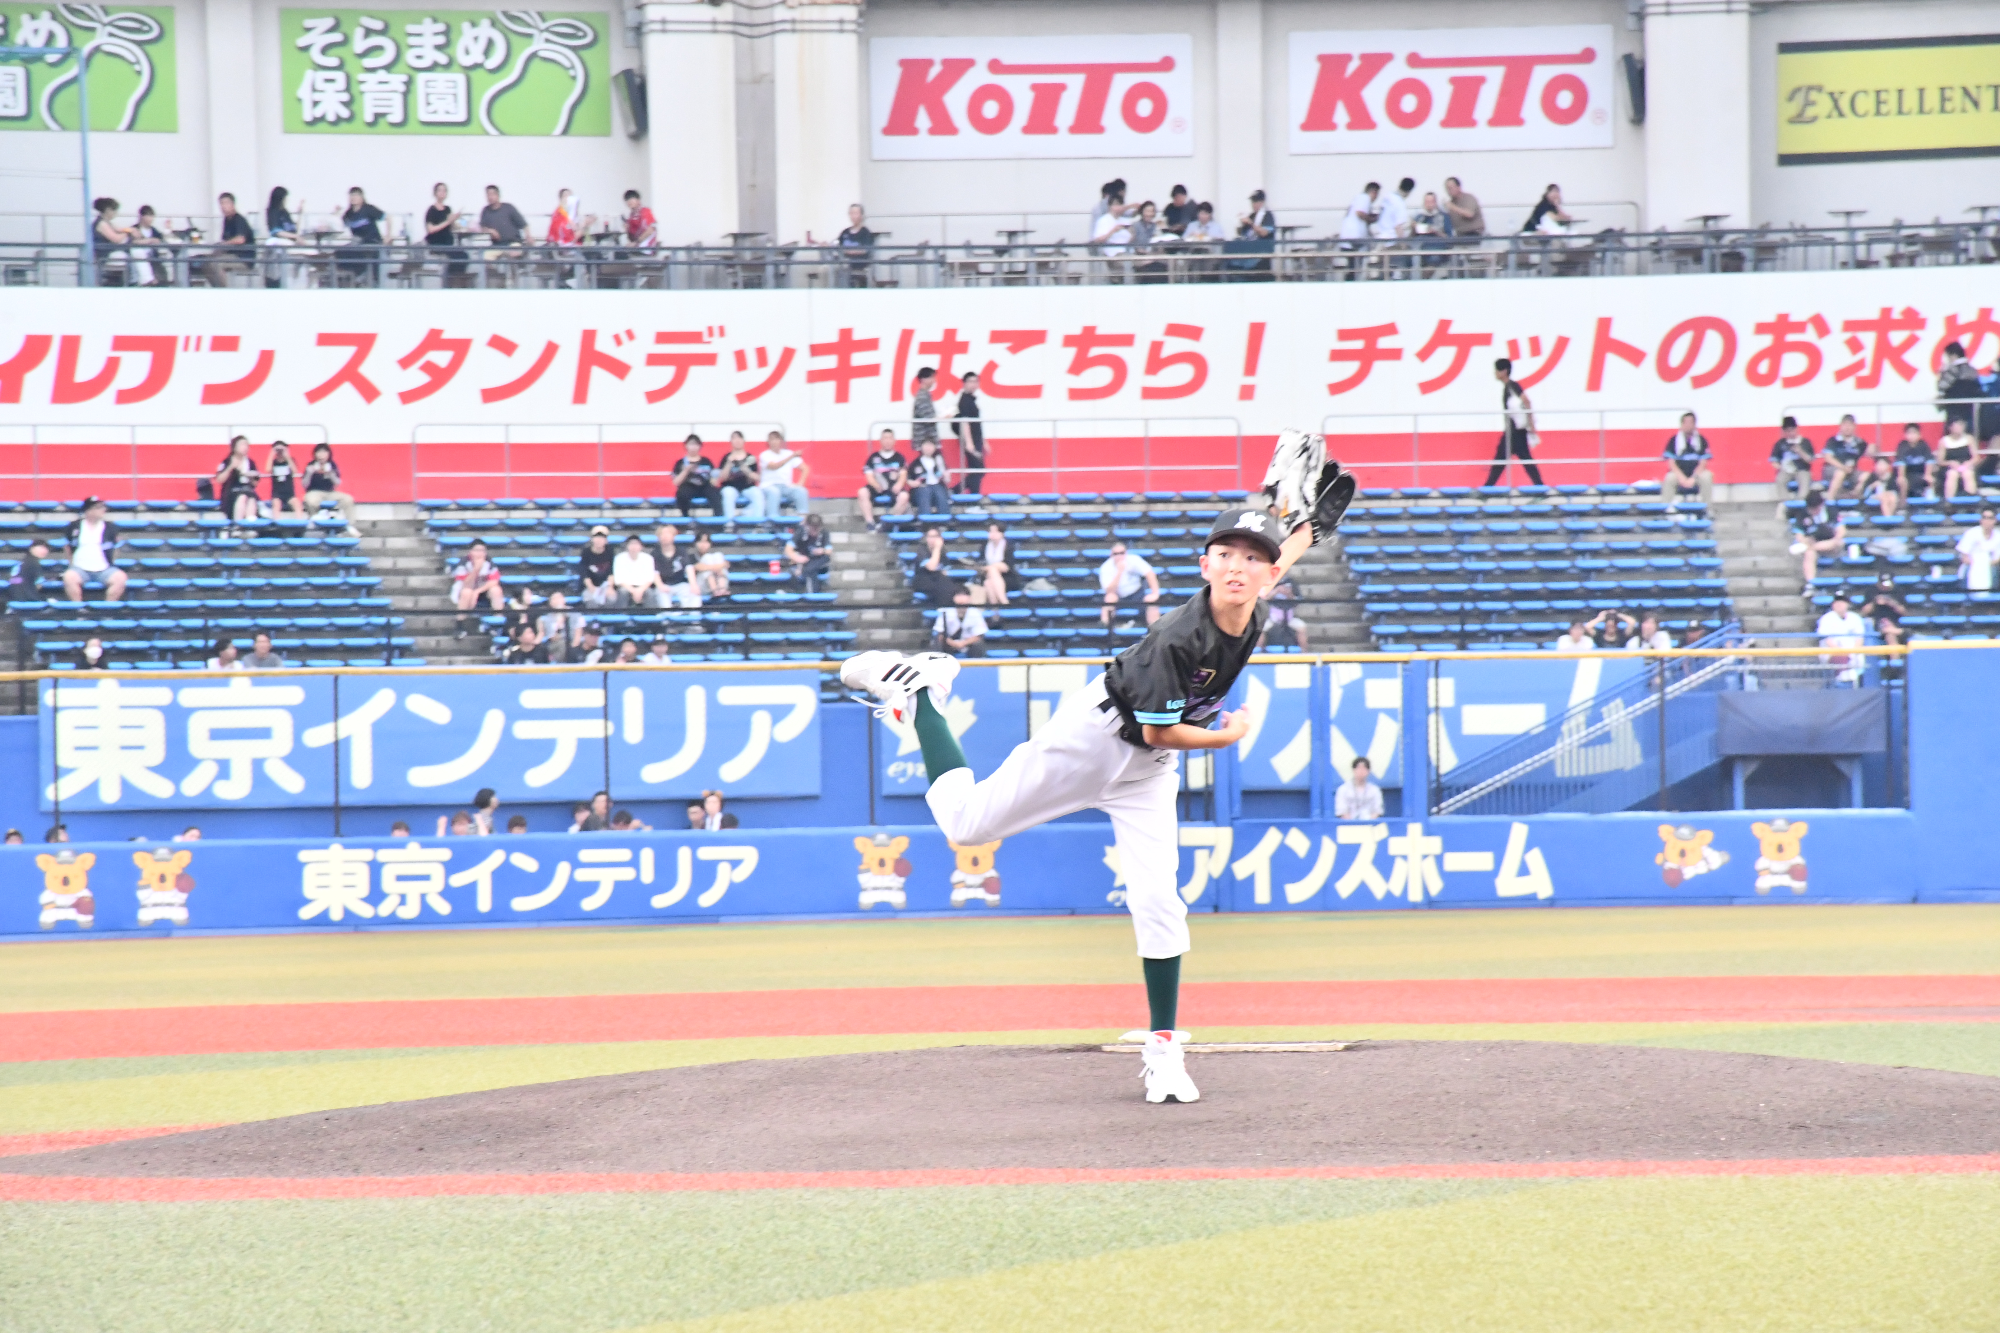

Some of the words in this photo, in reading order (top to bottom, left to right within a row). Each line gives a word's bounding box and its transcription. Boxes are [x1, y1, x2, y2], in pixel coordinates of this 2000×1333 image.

[0, 11, 69, 63] め
[296, 15, 508, 69] そらまめ
[297, 70, 470, 123] 保育園
[45, 677, 817, 804] 東京インテリア
[297, 843, 760, 921] 東京インテリア
[1178, 822, 1554, 905] アインズホーム
